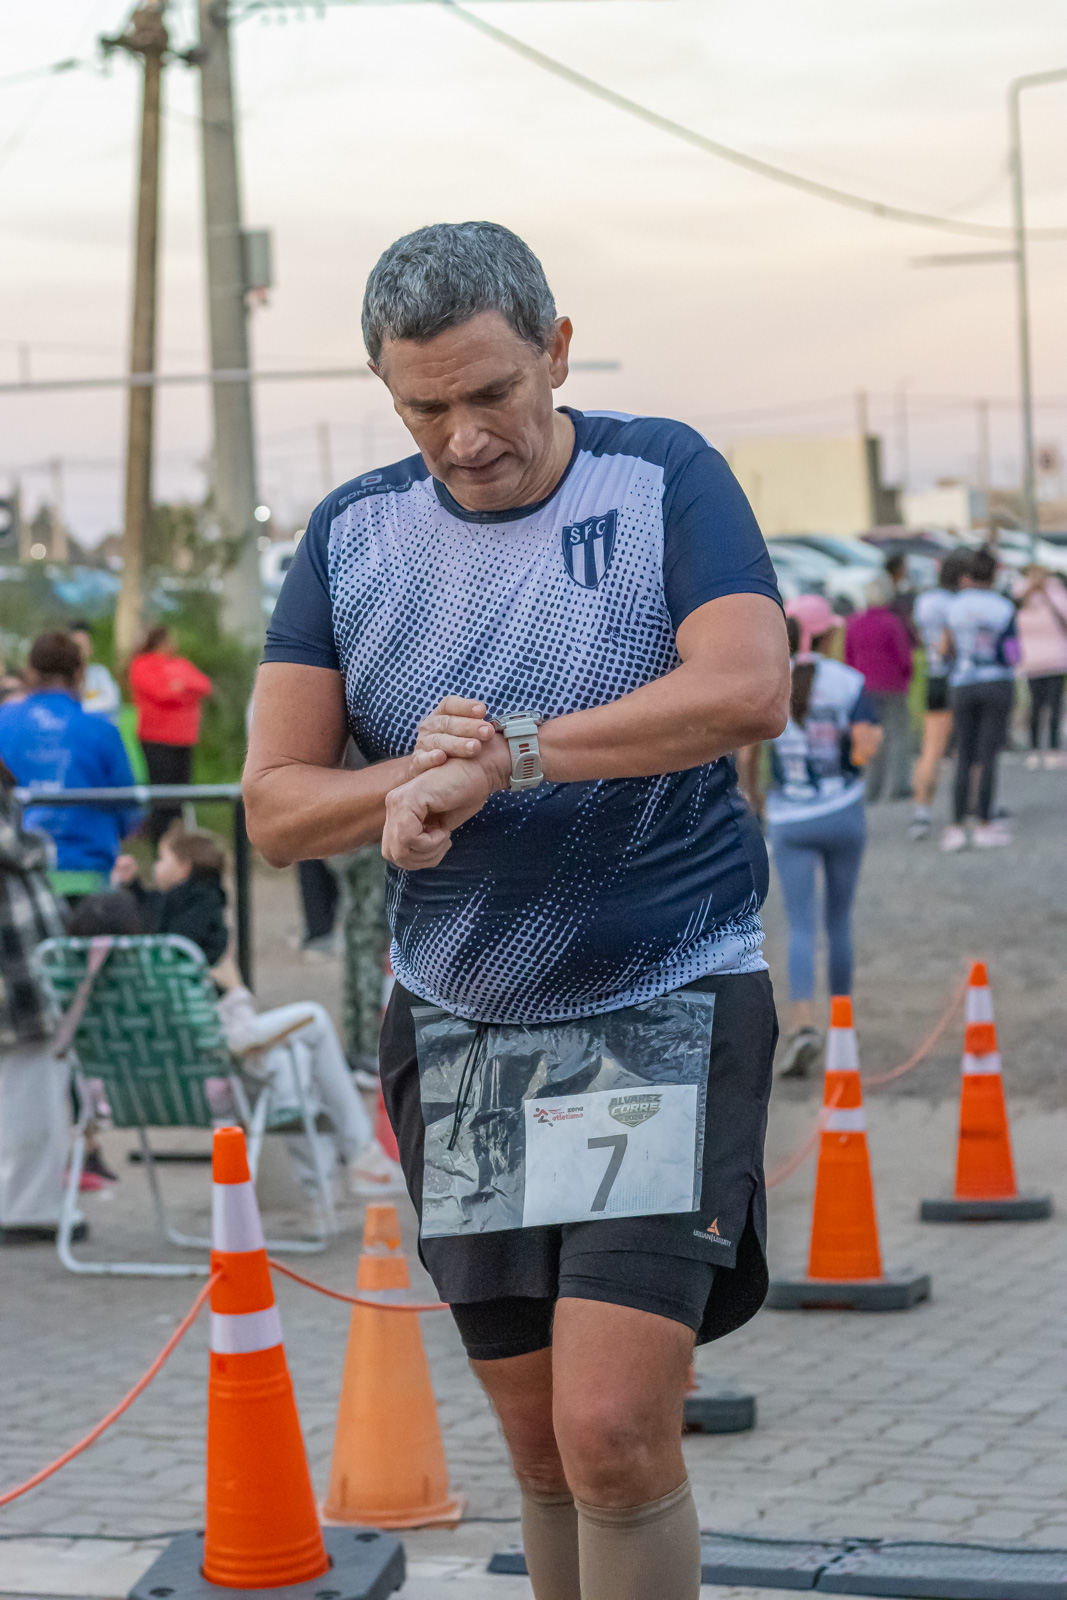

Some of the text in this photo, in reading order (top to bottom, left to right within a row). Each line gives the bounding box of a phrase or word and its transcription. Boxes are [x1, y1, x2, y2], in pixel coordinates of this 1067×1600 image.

[569, 519, 606, 543] SFC
[609, 1094, 664, 1106] ALVAREZ
[611, 1103, 660, 1116] CORRE
[587, 1134, 628, 1212] 7
